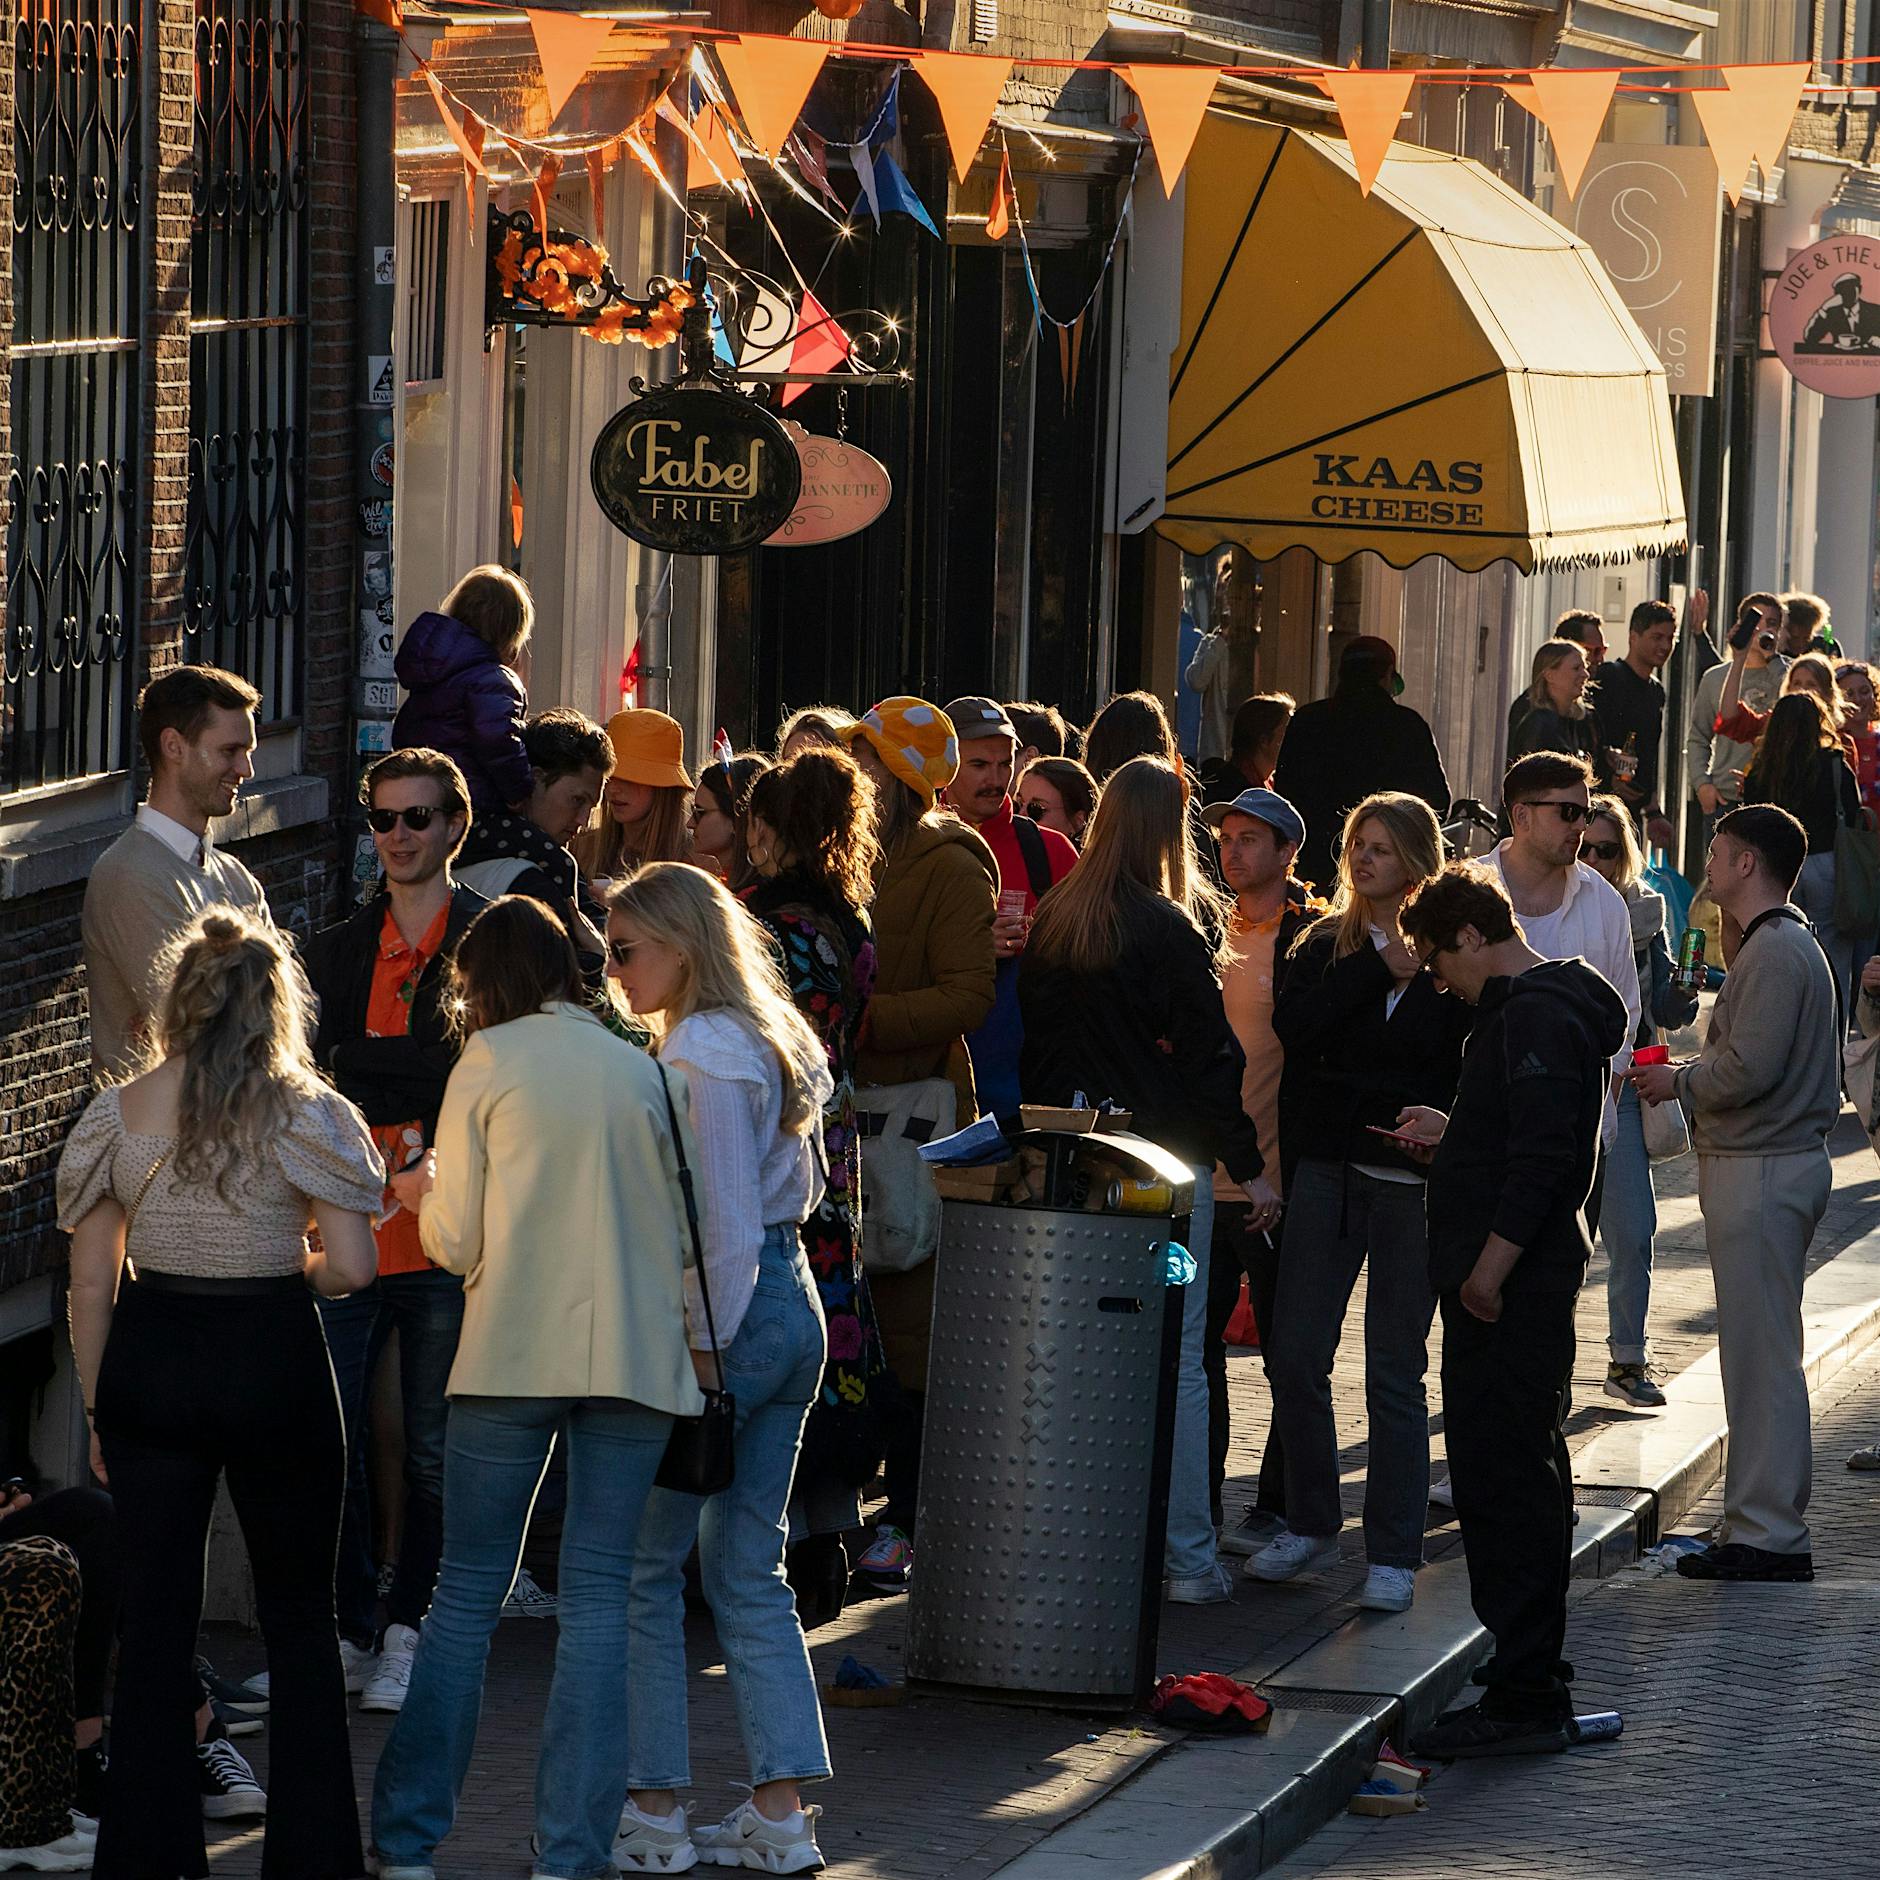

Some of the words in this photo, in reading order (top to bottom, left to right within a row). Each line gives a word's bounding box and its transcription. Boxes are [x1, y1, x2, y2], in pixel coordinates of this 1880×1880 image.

[1783, 263, 1814, 300] JOE
[1813, 252, 1830, 270] &
[1833, 246, 1872, 265] THE
[626, 419, 766, 499] Fabel
[1312, 453, 1483, 495] KAAS
[651, 497, 745, 524] FRIET
[1311, 494, 1483, 526] CHEESE
